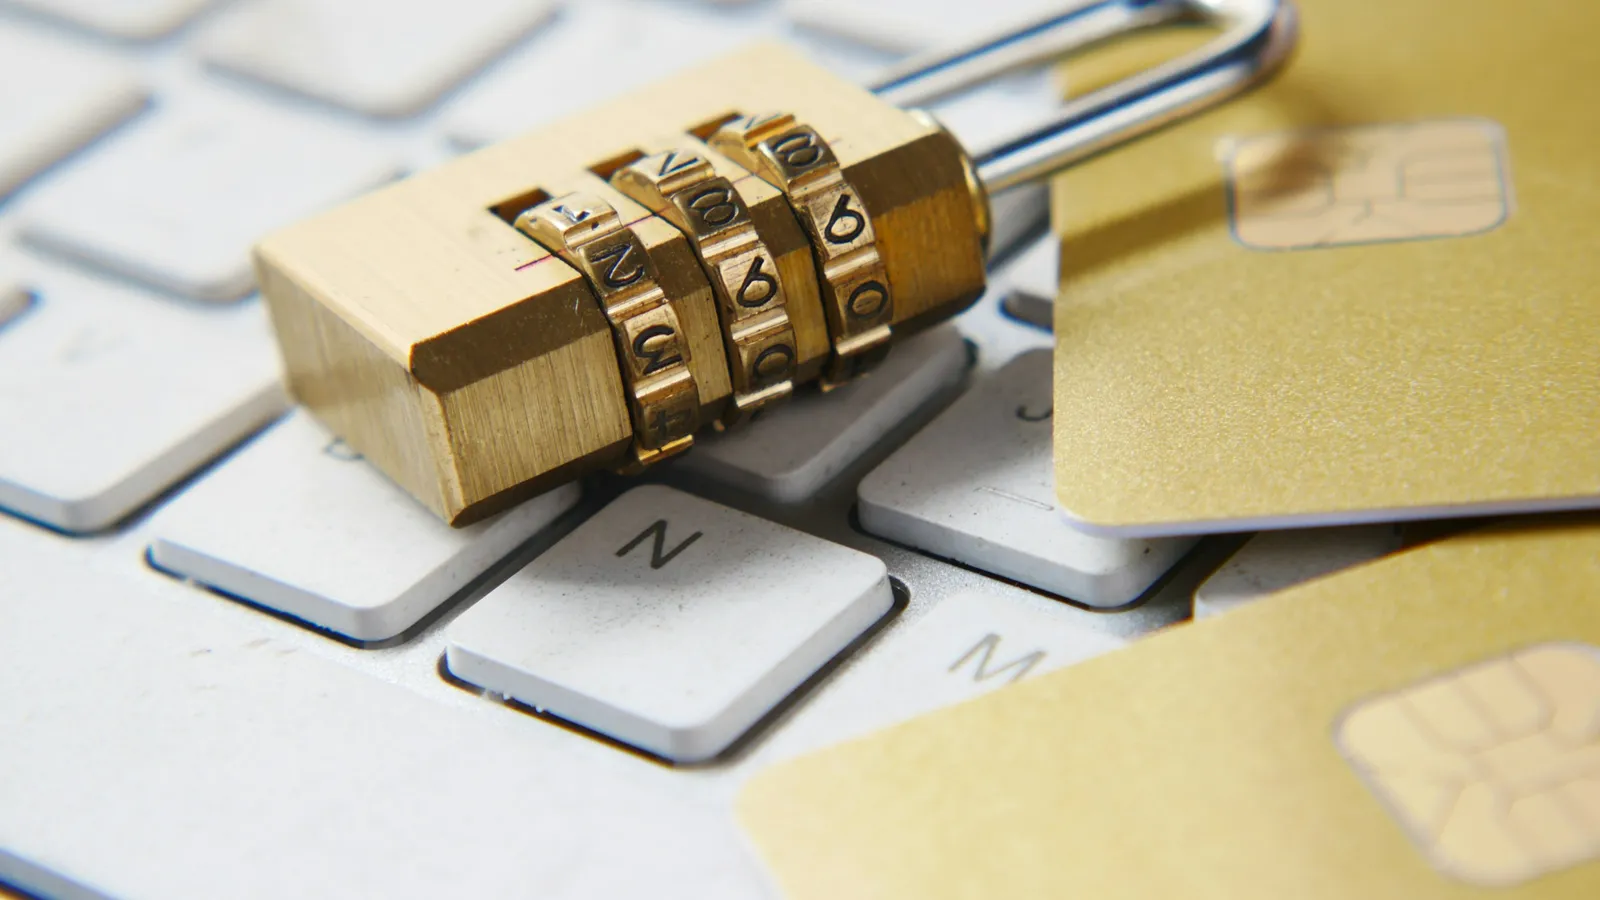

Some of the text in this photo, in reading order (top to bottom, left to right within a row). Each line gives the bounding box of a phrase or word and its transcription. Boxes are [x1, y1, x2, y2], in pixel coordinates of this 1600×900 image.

[773, 131, 824, 168] 8
[688, 185, 739, 227] 8
[589, 242, 645, 289] 2
[632, 323, 684, 377] 3
[614, 518, 703, 570] N
[946, 632, 1048, 683] M
